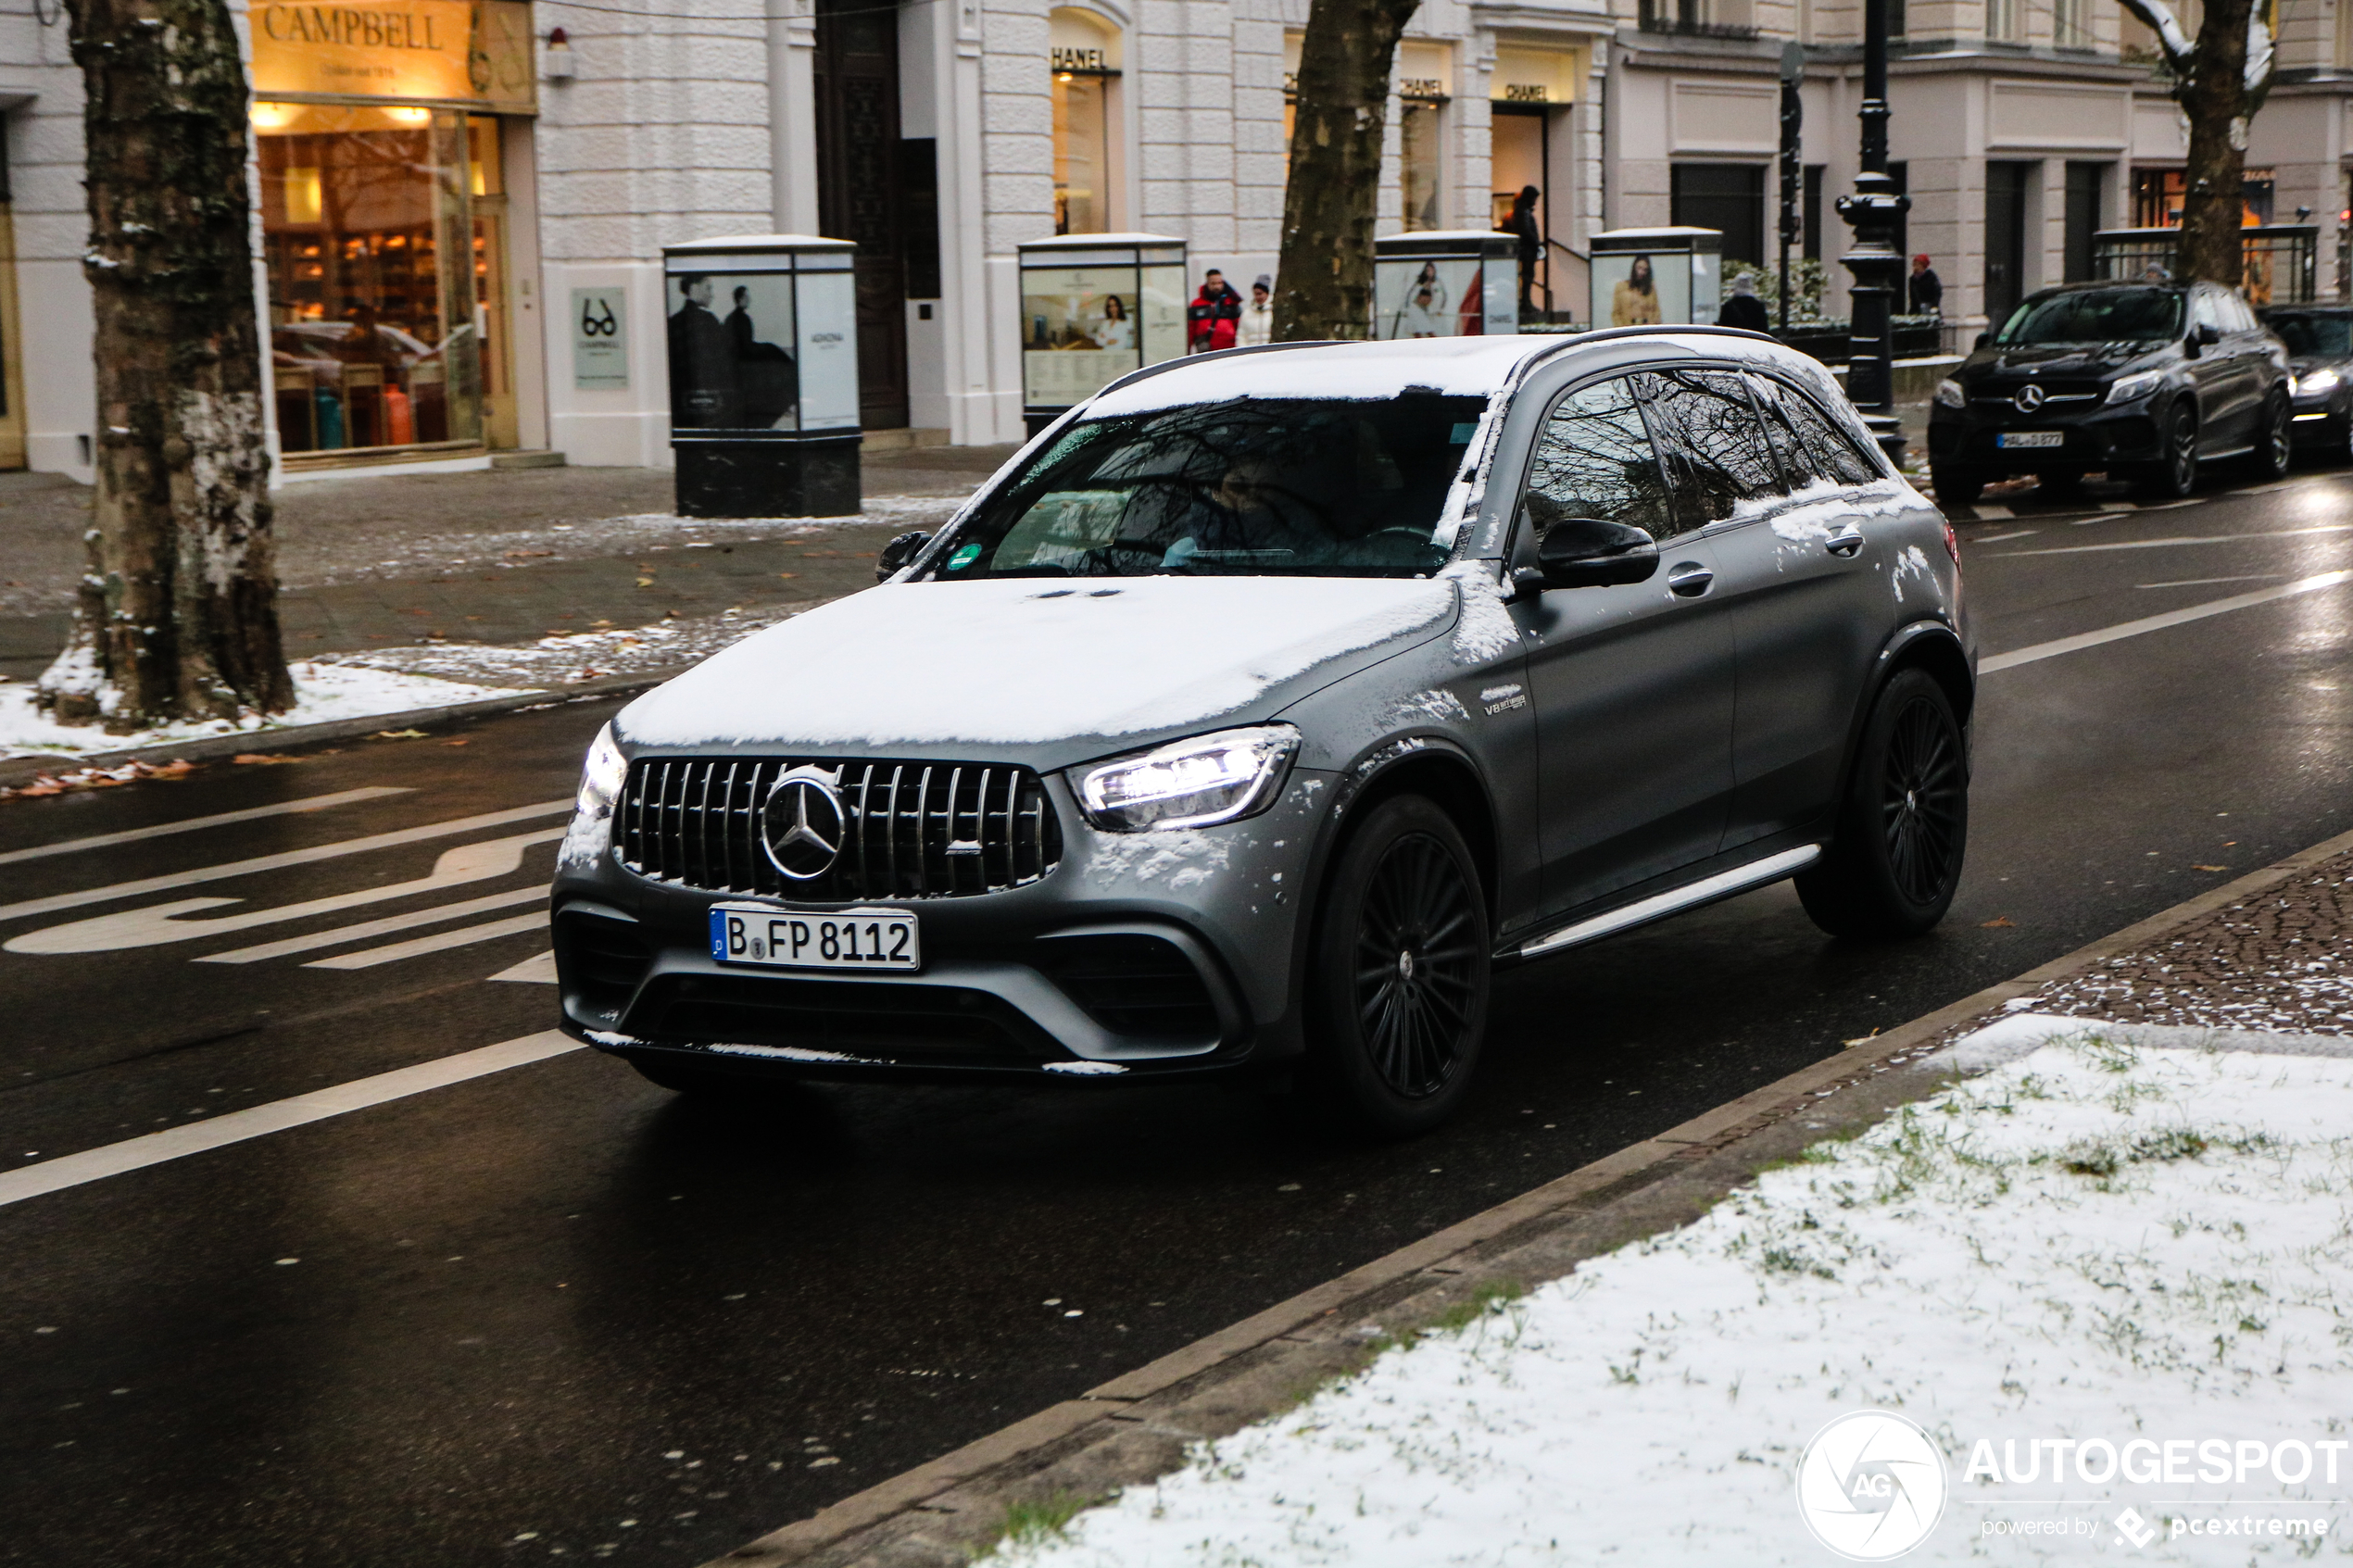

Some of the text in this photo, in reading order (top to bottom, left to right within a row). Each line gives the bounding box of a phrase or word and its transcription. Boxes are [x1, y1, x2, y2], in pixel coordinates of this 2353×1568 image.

[264, 4, 444, 50] CAMPBELL
[1051, 47, 1108, 69] HANEL
[1505, 83, 1549, 102] CHANEL
[1484, 703, 1501, 716] V8
[714, 939, 724, 951] D
[728, 917, 911, 962] B FP 8112
